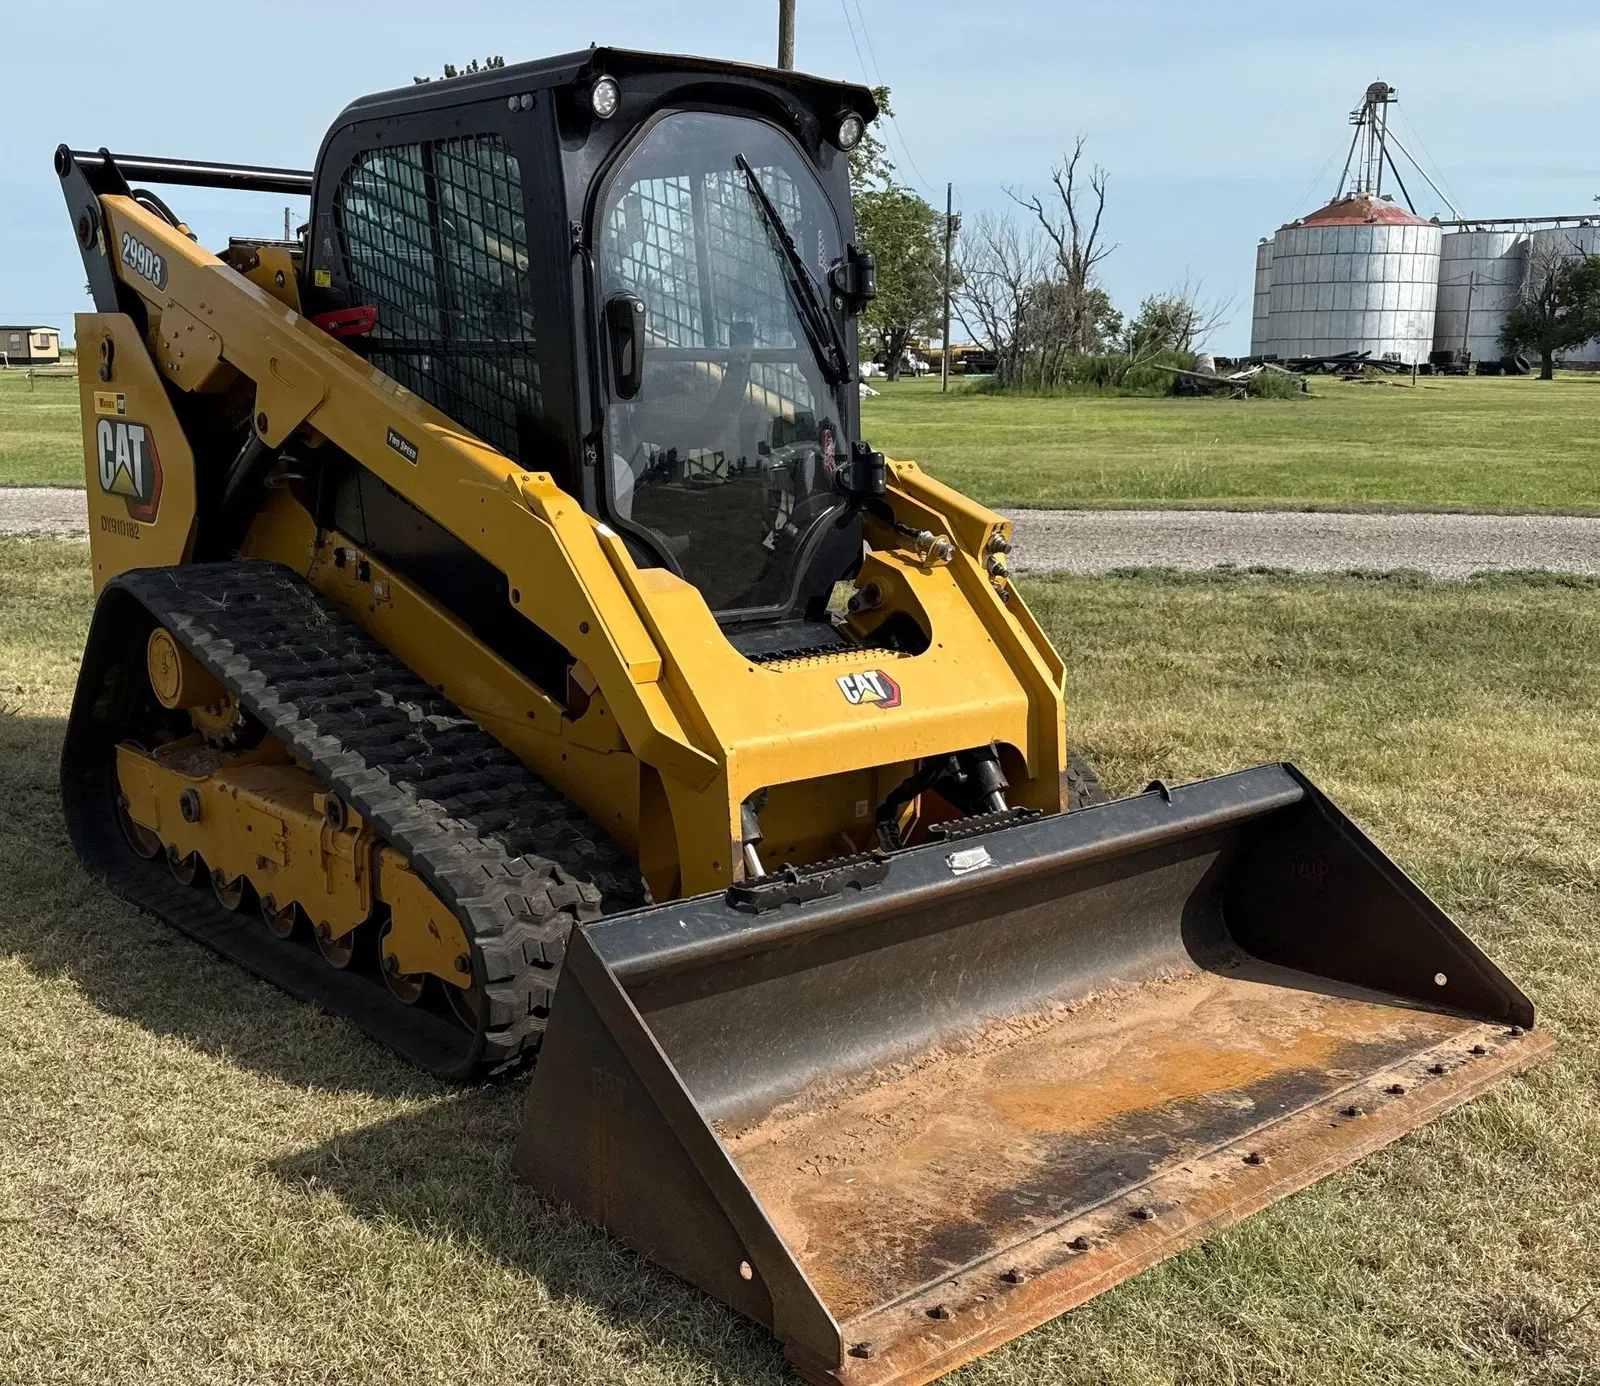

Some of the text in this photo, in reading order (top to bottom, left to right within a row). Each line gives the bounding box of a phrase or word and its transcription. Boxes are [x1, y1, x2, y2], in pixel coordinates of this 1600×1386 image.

[122, 232, 161, 286] 299D3
[97, 419, 145, 498] CAT
[101, 515, 141, 540] DY910182
[836, 670, 888, 704] CAT
